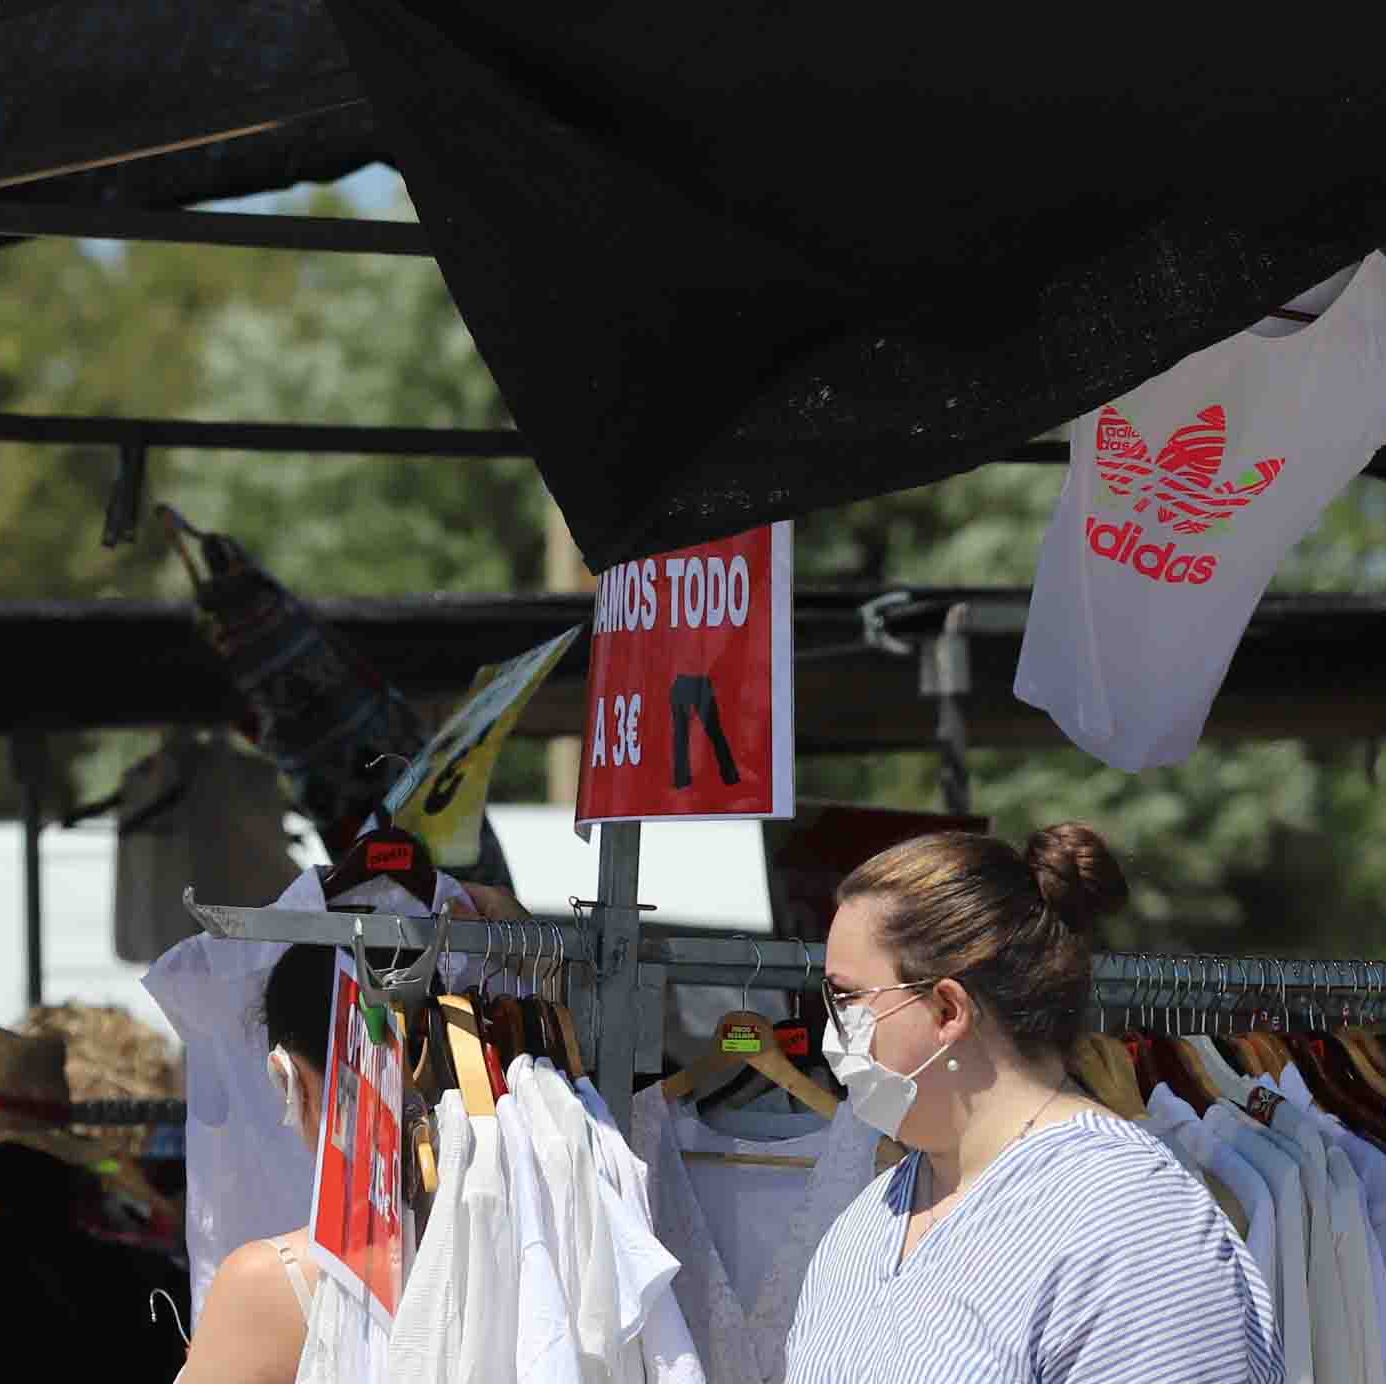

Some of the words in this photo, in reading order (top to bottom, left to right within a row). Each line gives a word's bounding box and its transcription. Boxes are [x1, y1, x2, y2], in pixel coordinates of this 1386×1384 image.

[666, 555, 750, 629] TODO
[591, 696, 606, 768] A
[612, 693, 643, 768] 3€
